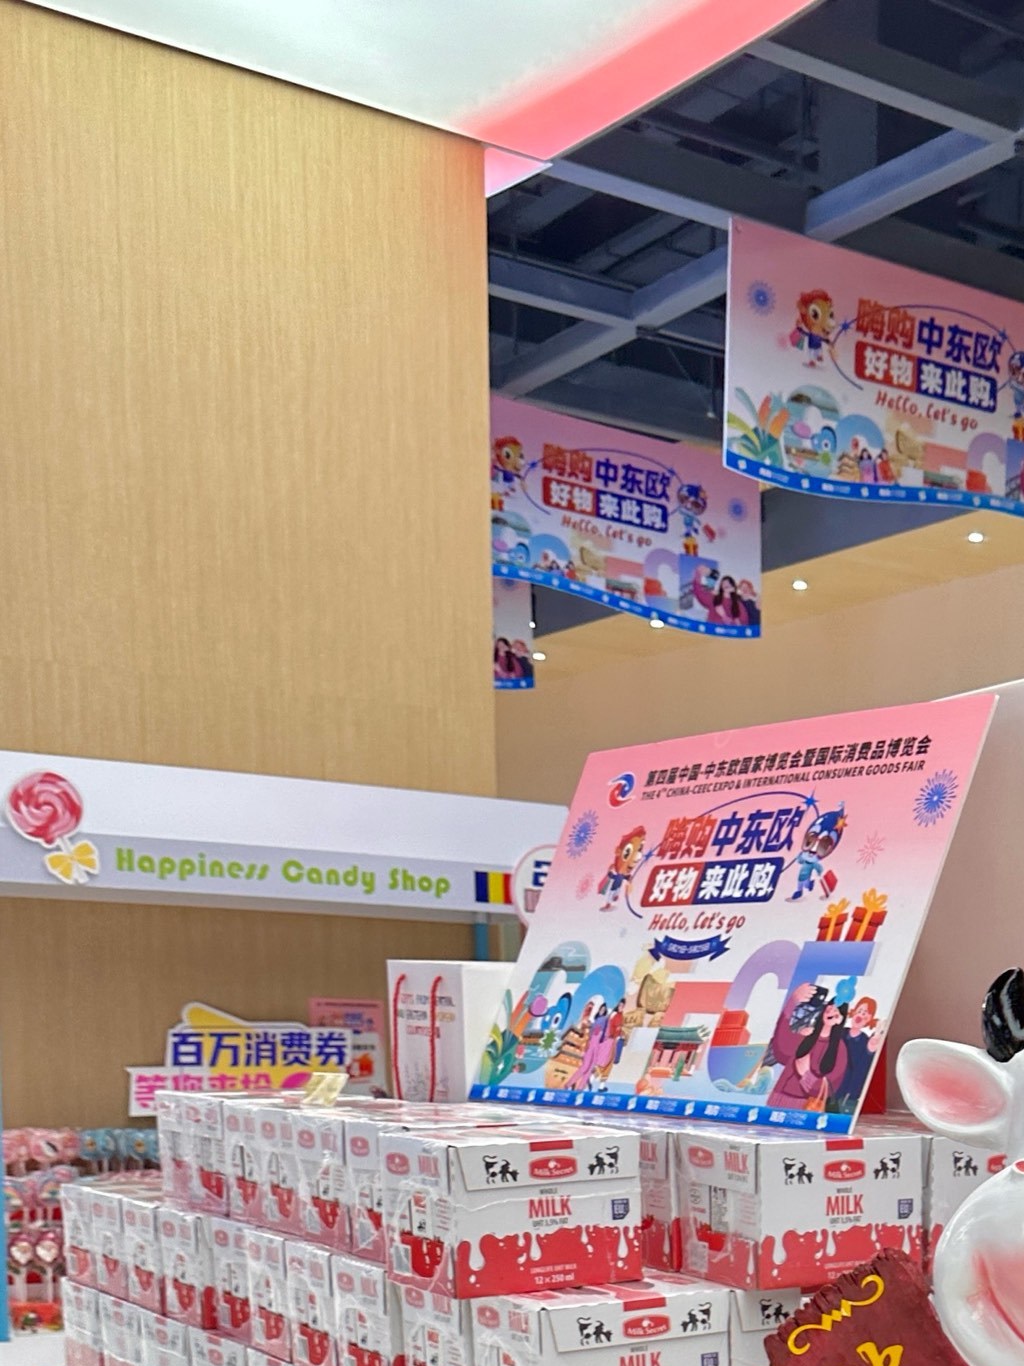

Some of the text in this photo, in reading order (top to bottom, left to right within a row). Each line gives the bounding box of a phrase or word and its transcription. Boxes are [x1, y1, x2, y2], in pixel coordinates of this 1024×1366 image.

[960, 416, 979, 432] go
[641, 790, 656, 801] THE
[666, 785, 713, 798] CHINA-CEEC
[712, 780, 736, 793] EXPO
[735, 779, 742, 790] &
[742, 770, 811, 789] INTERNATIONAL
[811, 765, 865, 782] CONSUMER
[865, 762, 902, 777] GOODS
[901, 760, 926, 773] FAIR
[115, 847, 452, 899] Happiness Candy Shop
[725, 915, 746, 934] go
[170, 1031, 348, 1068] 百万消费券
[529, 1195, 572, 1219] MILK
[826, 1194, 864, 1217] MILK
